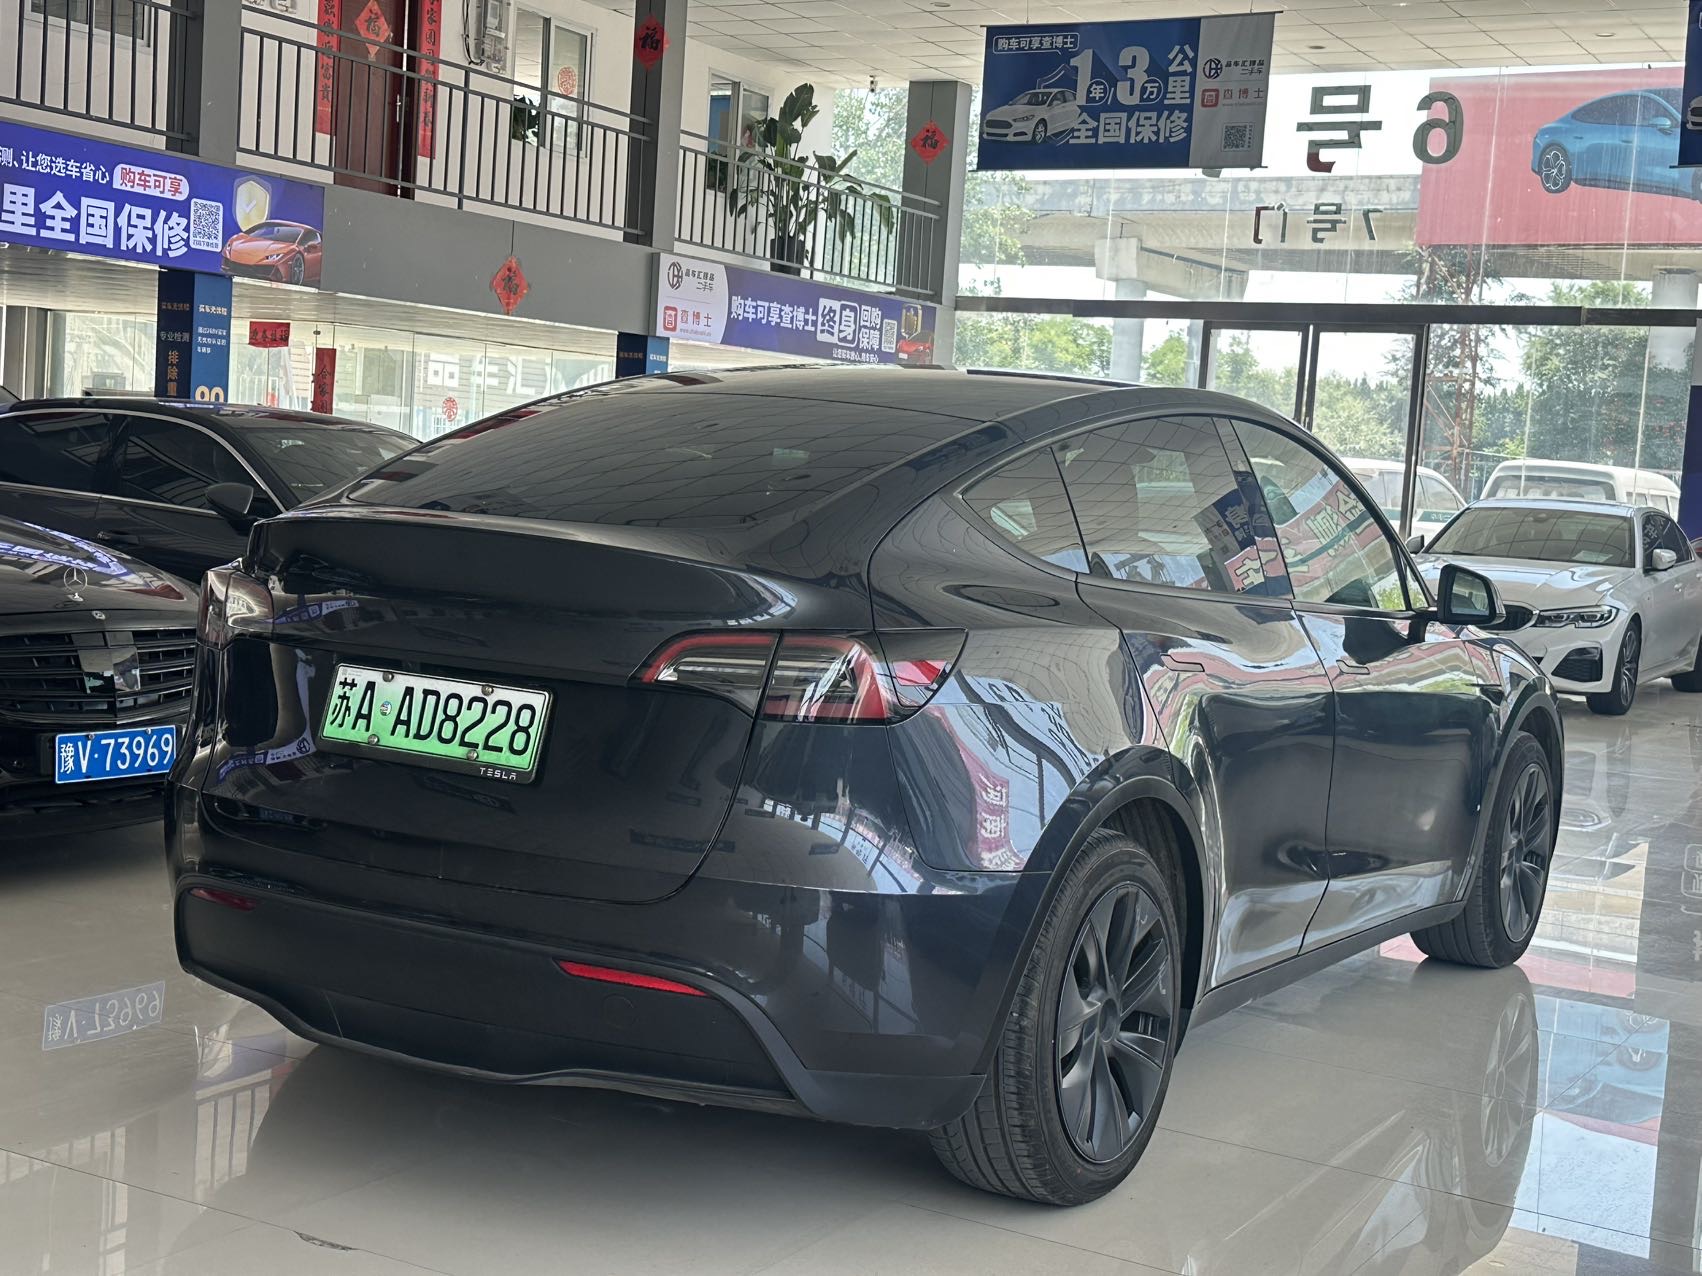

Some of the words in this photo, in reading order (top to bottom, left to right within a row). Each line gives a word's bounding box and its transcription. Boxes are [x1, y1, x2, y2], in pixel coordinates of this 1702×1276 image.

[640, 26, 660, 51] 福
[997, 36, 1075, 51] 购车可享查博士
[921, 129, 940, 150] 福
[1068, 110, 1190, 145] 全国保修
[119, 167, 184, 198] 购车可享
[0, 183, 189, 258] 里全国保修
[502, 266, 520, 296] 福
[731, 295, 817, 332] 购车可享查博士
[819, 304, 856, 341] 终身
[860, 305, 882, 329] 回购
[858, 329, 881, 351] 保障
[480, 767, 517, 780] TESLA
